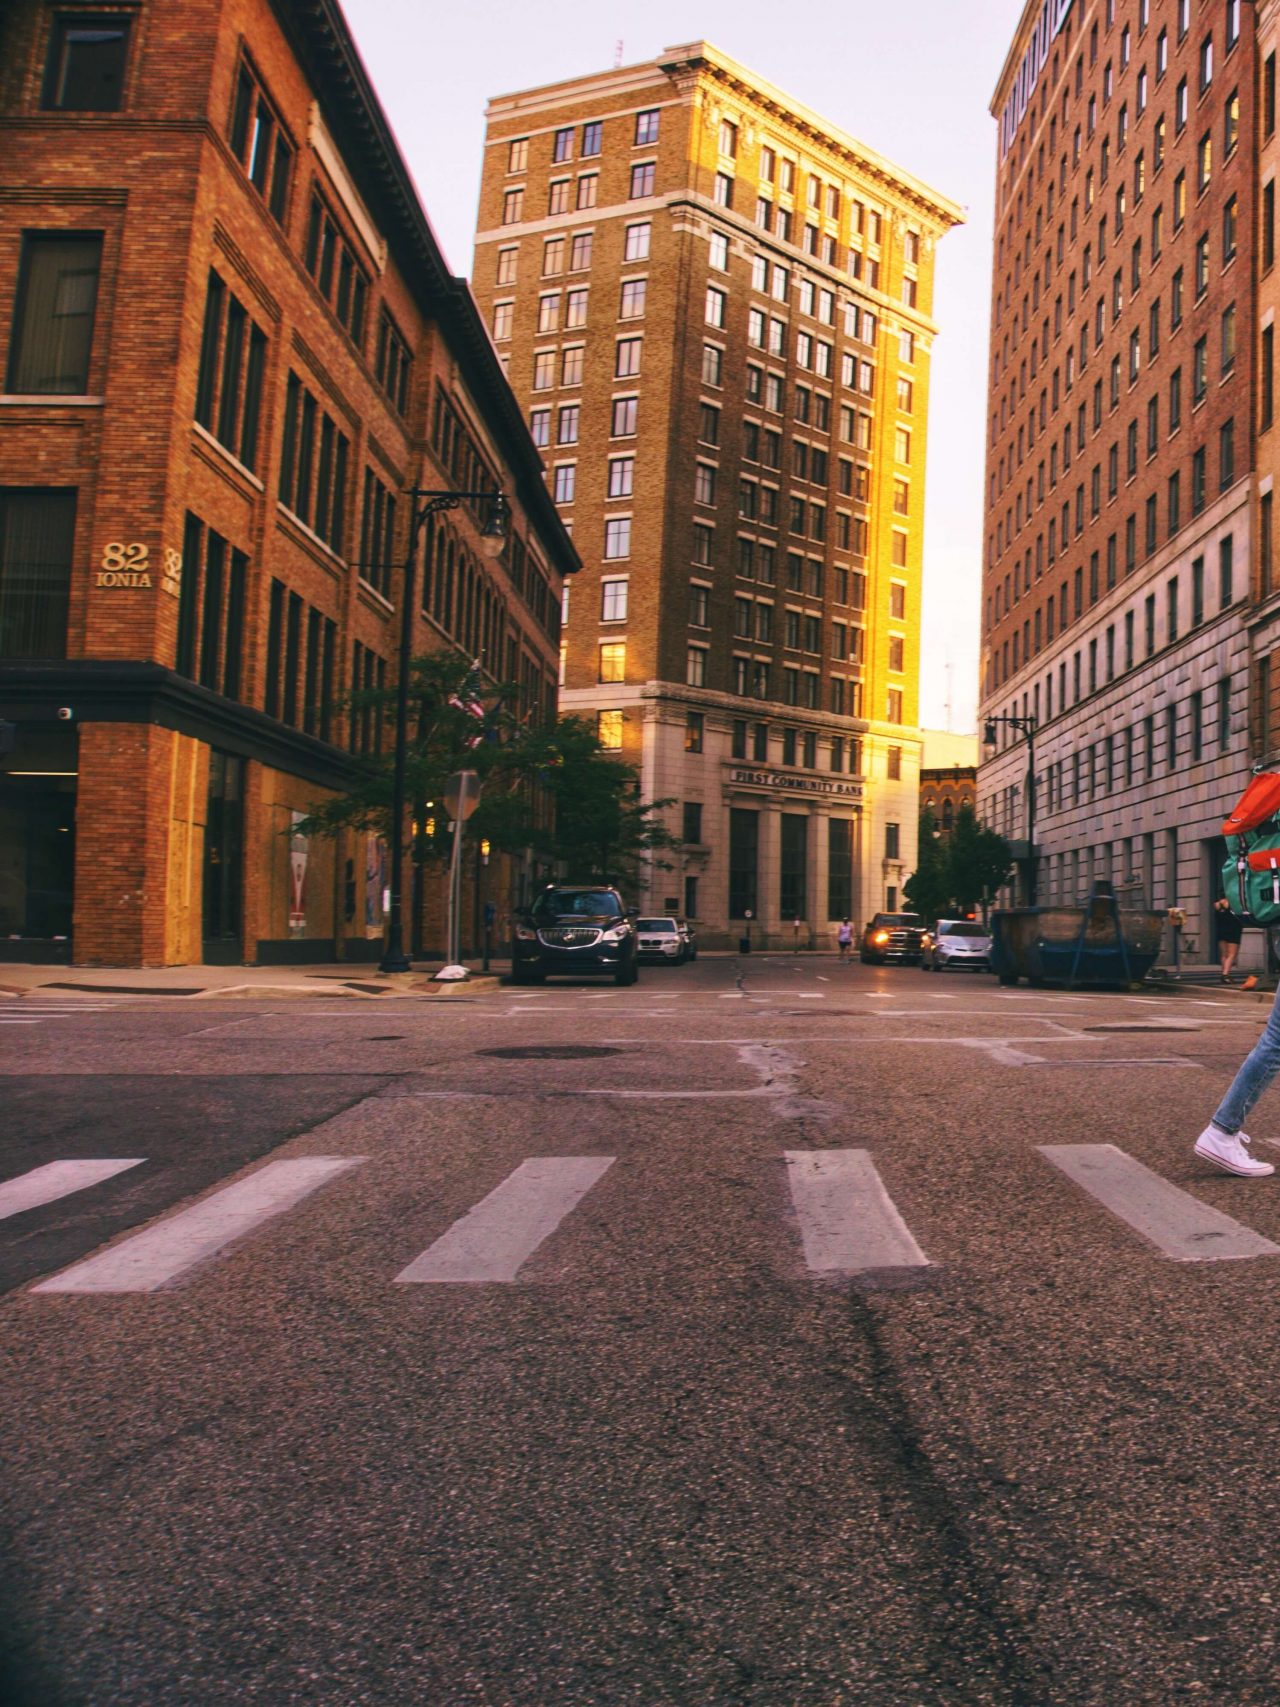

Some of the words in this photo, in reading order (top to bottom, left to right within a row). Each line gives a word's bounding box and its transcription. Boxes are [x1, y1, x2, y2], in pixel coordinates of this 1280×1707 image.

[101, 542, 149, 572] 82
[95, 572, 152, 588] IONIA
[736, 771, 769, 785] FIRST
[773, 775, 834, 792] COMMUNITY
[836, 784, 863, 796] BANK
